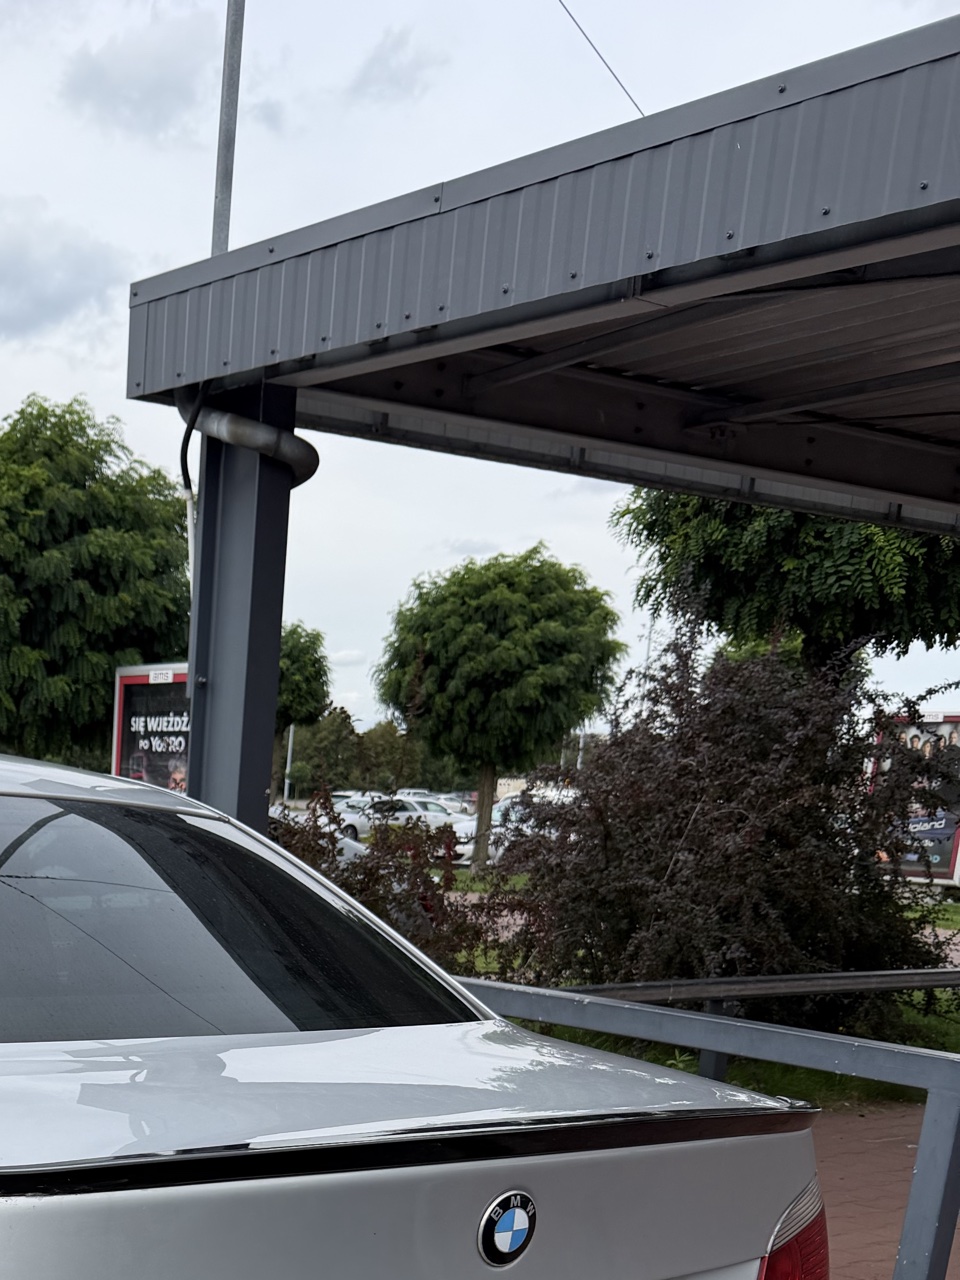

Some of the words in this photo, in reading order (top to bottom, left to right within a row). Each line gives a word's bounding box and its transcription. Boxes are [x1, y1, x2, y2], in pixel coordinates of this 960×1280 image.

[130, 715, 146, 735] SIĘ
[146, 711, 191, 733] WJEŻDŻ
[138, 739, 150, 750] PO
[490, 1194, 536, 1222] BMW
